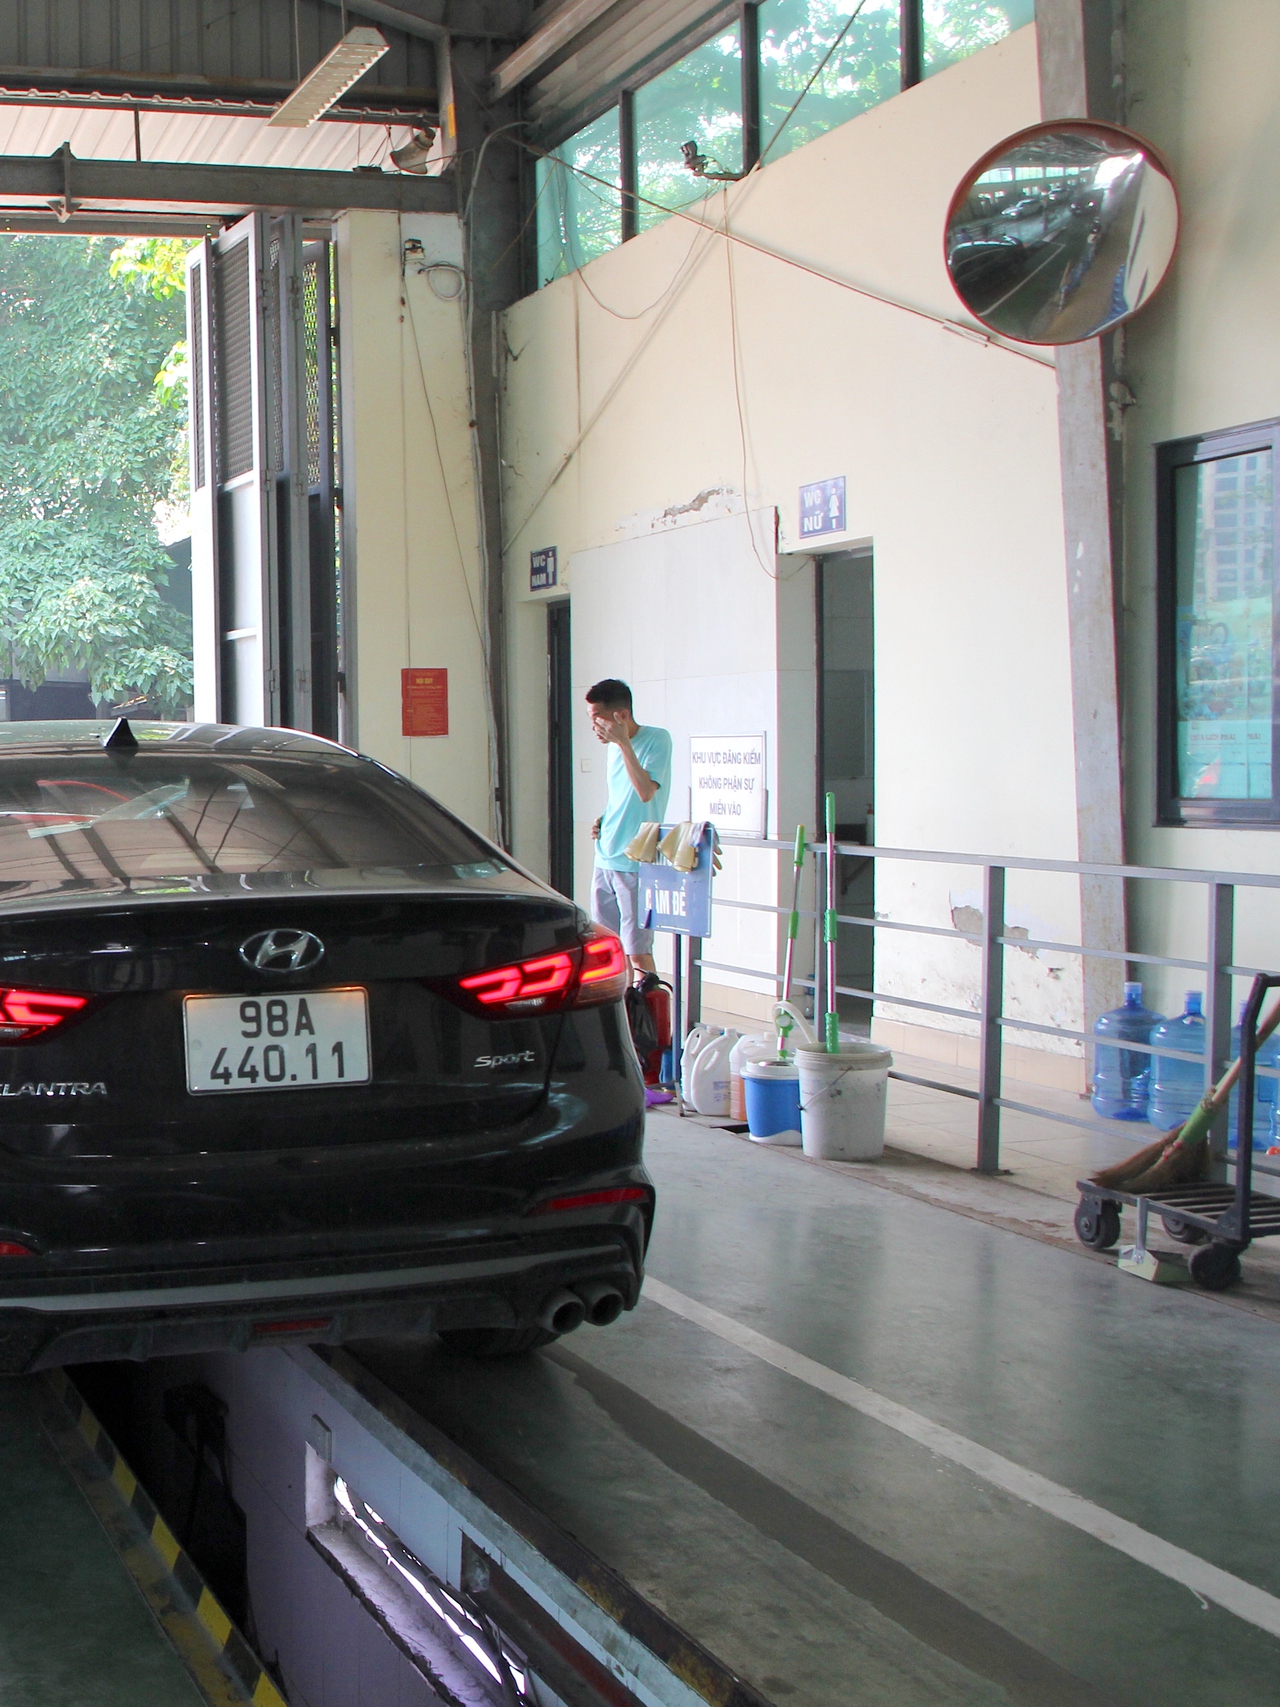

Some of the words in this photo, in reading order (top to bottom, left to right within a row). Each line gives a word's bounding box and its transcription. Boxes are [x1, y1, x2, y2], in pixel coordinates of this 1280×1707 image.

[803, 489, 822, 508] WC
[803, 510, 824, 532] NỮ
[532, 555, 546, 568] WC
[531, 573, 547, 587] NAM
[692, 752, 706, 764] KHU
[707, 751, 721, 767] VỰC
[722, 749, 741, 764] ĐĂNG
[743, 748, 761, 765] KIỂM
[699, 775, 722, 789] KHÔNG
[723, 775, 742, 792] PHẬN
[743, 776, 755, 793] SỰ
[727, 801, 741, 816] VÀO
[239, 997, 316, 1039] 98A
[210, 1041, 345, 1086] 440.11
[473, 1050, 535, 1068] Sport
